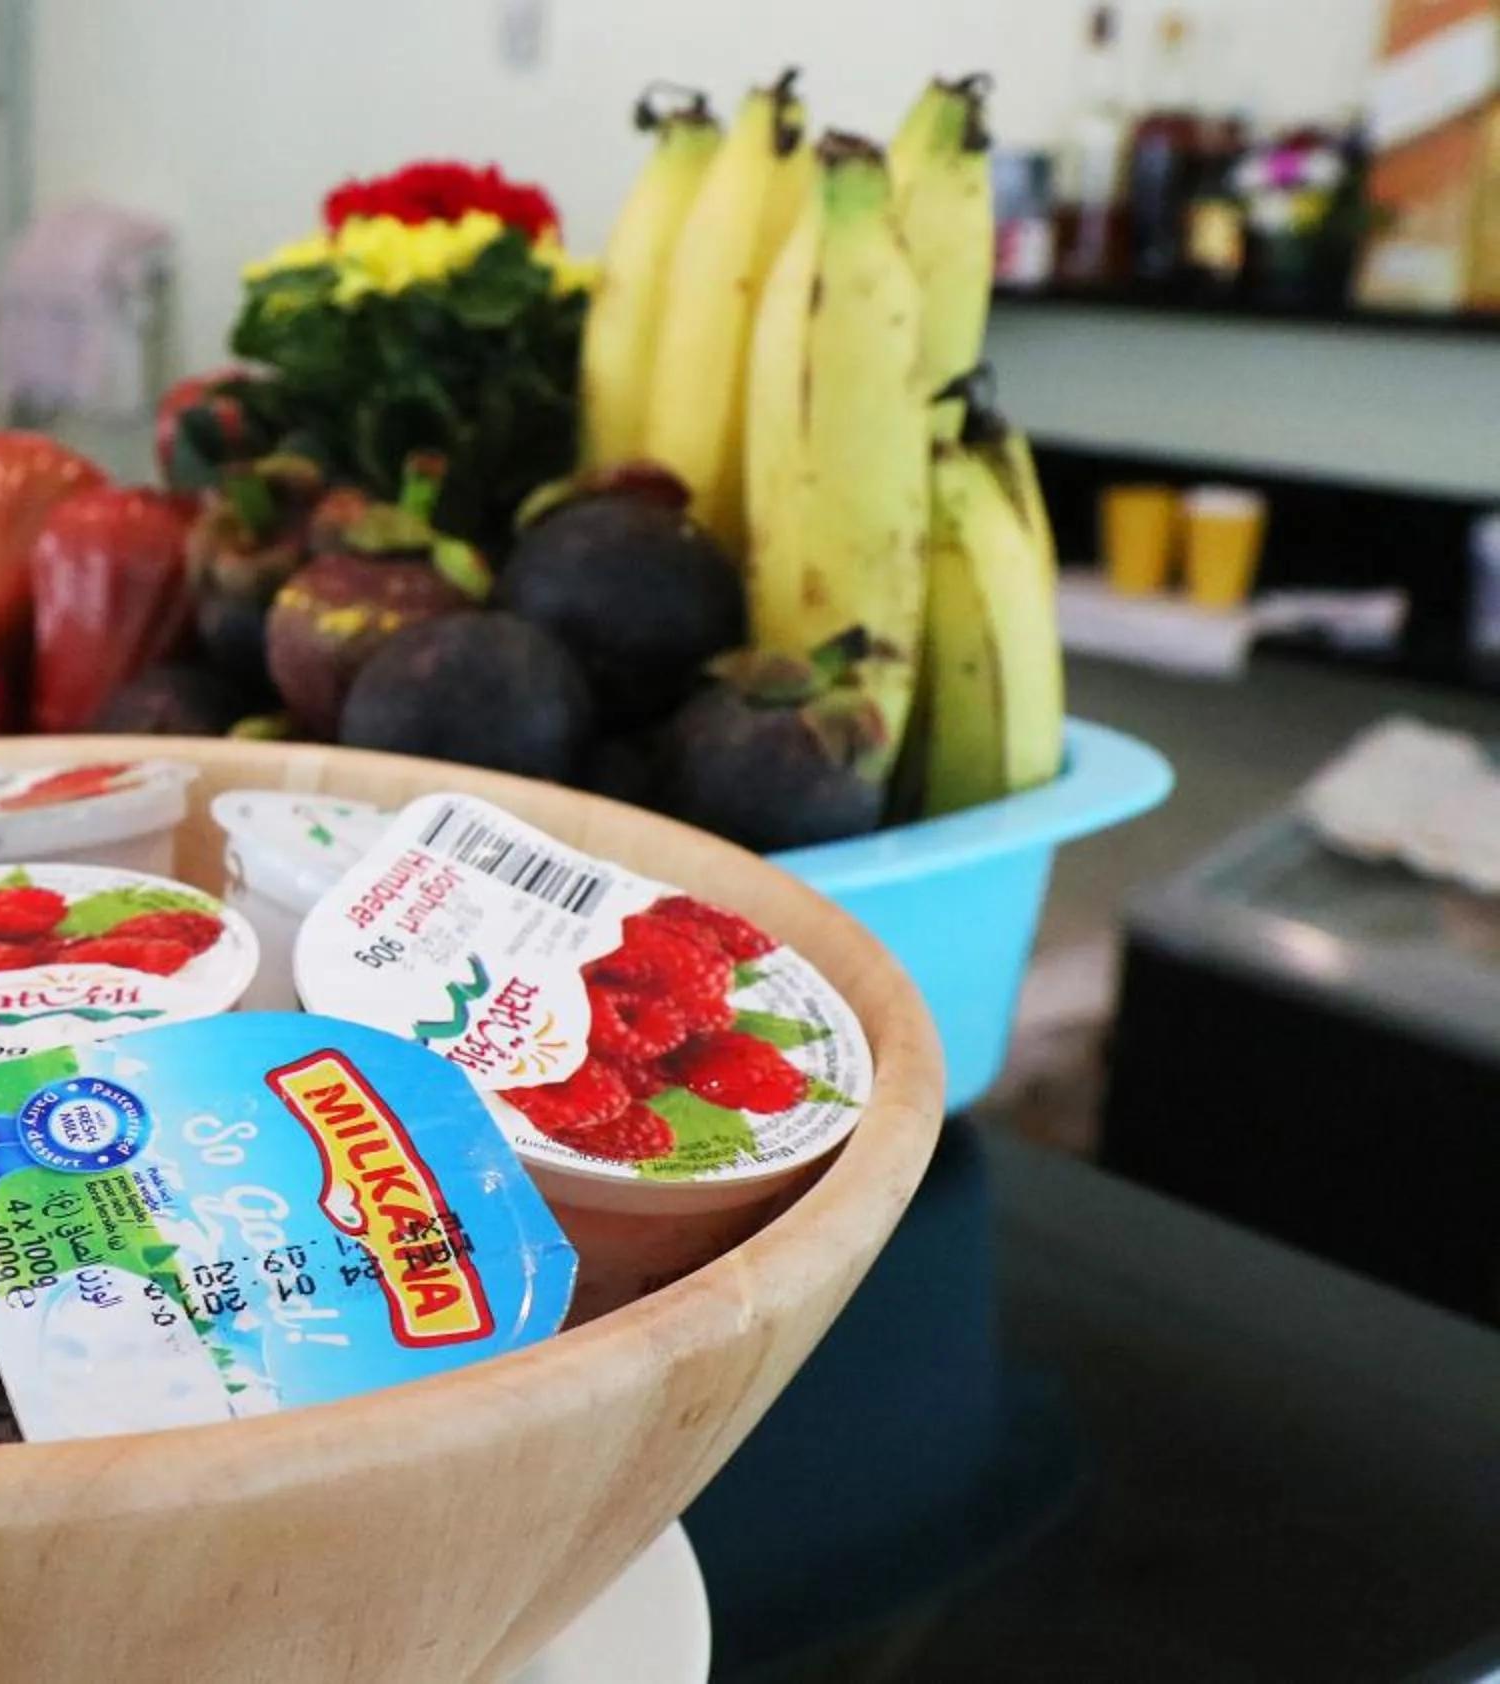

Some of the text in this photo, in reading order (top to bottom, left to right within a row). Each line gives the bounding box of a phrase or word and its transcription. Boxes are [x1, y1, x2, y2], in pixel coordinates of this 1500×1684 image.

[345, 847, 436, 930] Himbeer
[395, 864, 466, 934] Joghurt
[353, 935, 405, 968] 90g
[74, 1105, 100, 1143] FRESH
[91, 1082, 144, 1155] Pasteurized
[303, 1082, 461, 1318] MILKANA
[7, 1200, 33, 1215] 4
[20, 1235, 58, 1290] 100g
